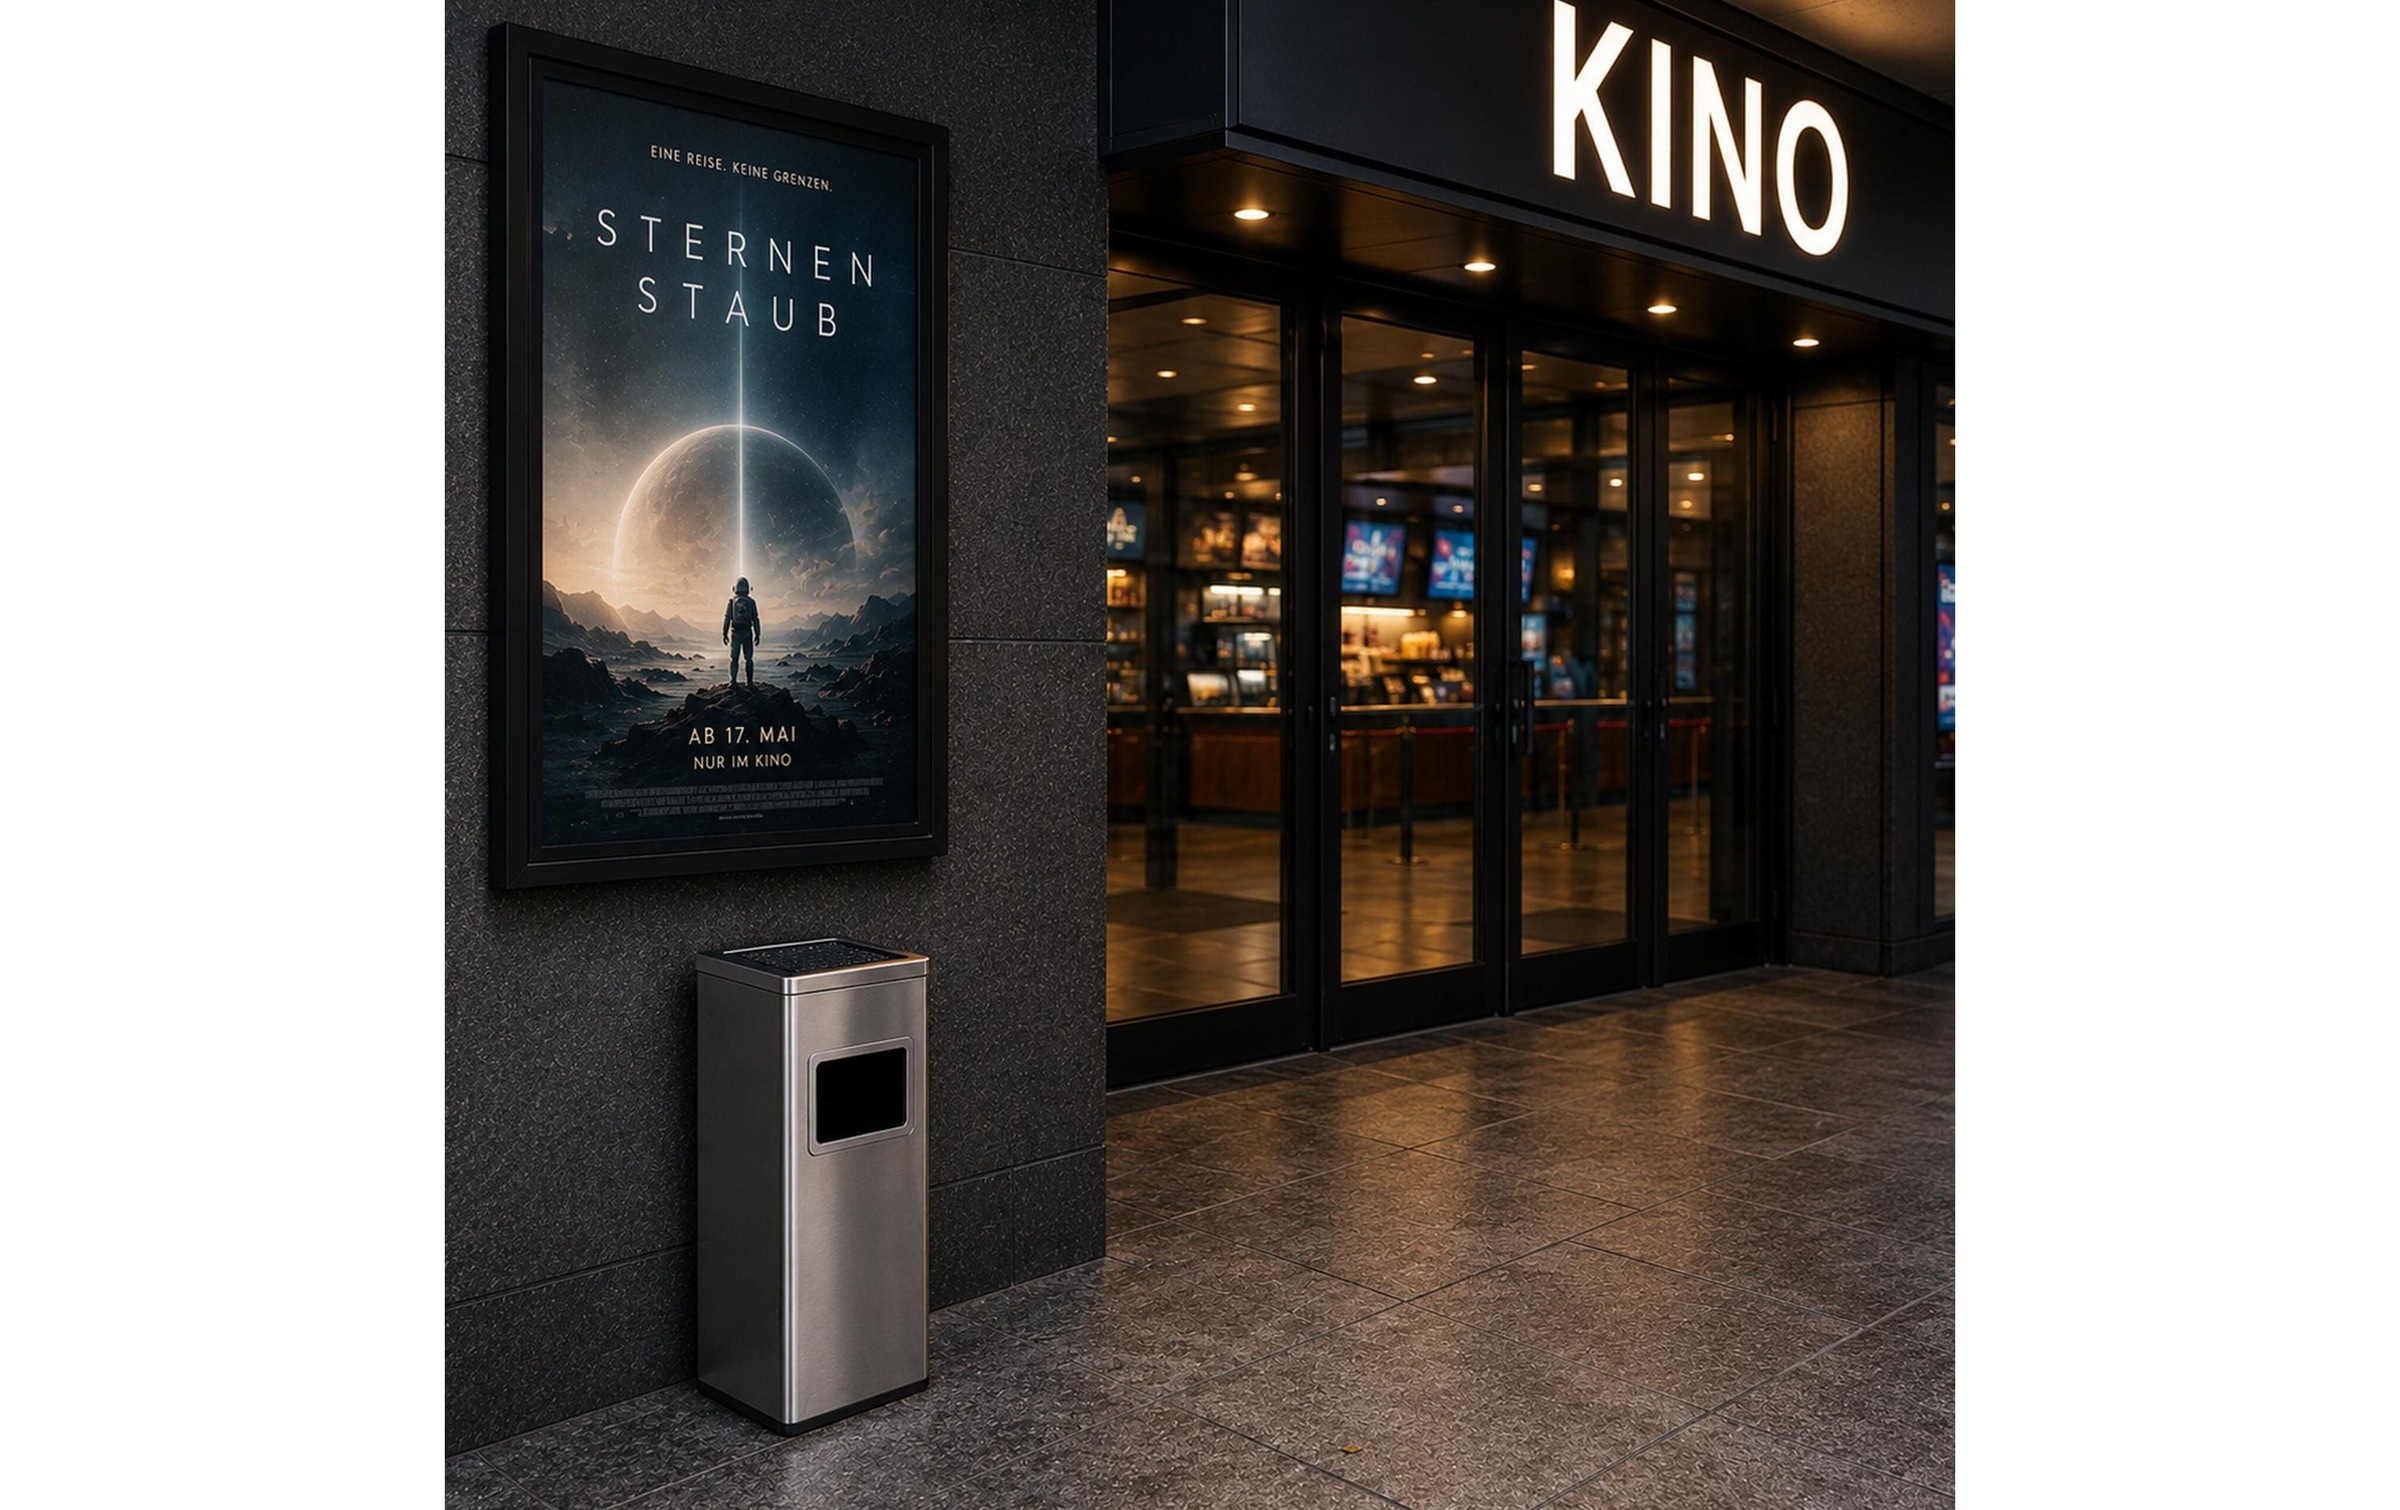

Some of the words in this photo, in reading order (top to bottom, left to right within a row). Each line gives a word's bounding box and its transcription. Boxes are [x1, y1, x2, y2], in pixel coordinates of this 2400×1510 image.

[1553, 0, 1849, 256] KINO
[650, 144, 681, 163] EINE
[686, 152, 727, 172] REISE.
[732, 161, 769, 180] KEINE
[773, 169, 833, 192] GRENZEN.
[597, 208, 872, 288] STERNEN
[637, 276, 837, 337] STAUB
[688, 726, 715, 745] AB
[725, 726, 750, 744] 17.
[759, 725, 796, 743] MAI
[693, 755, 725, 770] NUR
[732, 755, 749, 768] IM
[755, 753, 792, 767] KINO
